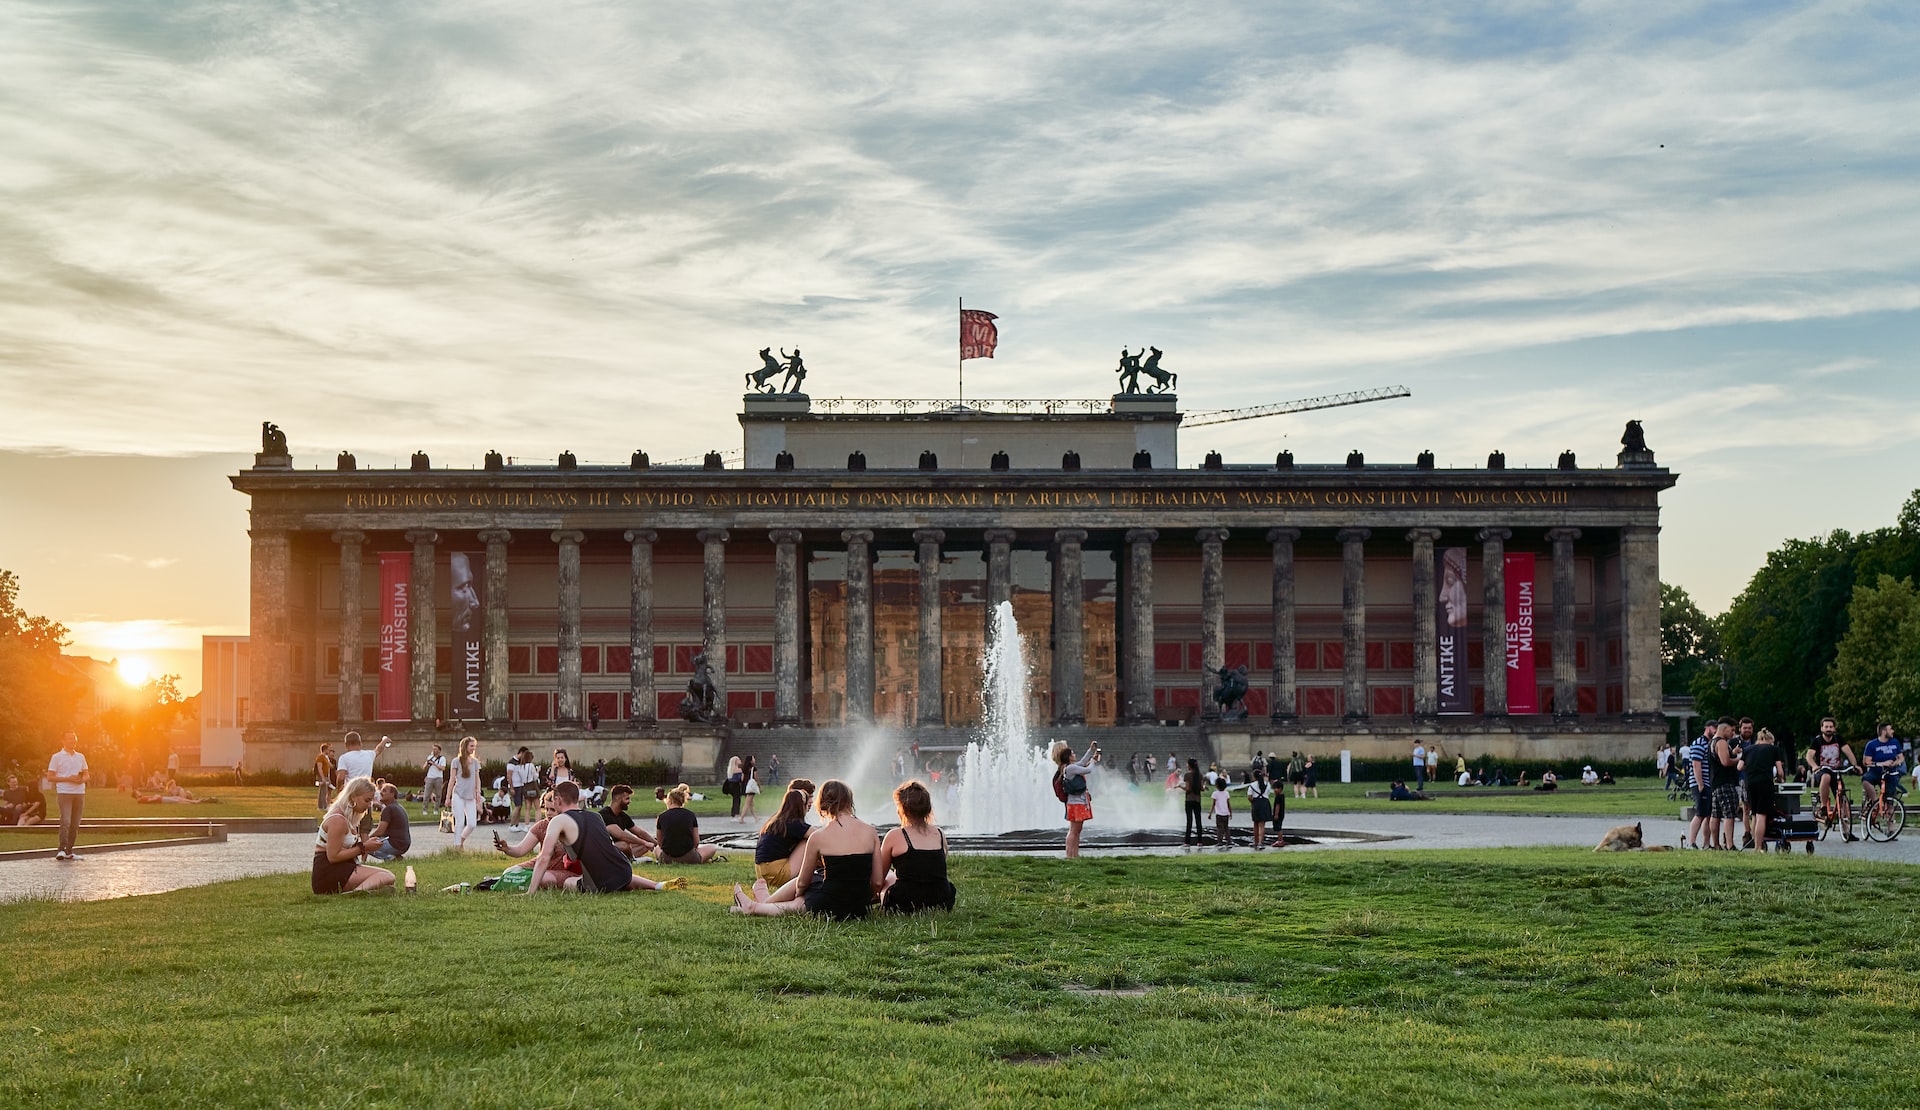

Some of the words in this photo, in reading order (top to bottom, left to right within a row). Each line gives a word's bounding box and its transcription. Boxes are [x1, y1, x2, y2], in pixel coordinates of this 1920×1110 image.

[346, 492, 457, 506] FRIDERICVS
[589, 492, 609, 506] III
[621, 492, 694, 506] STVDIO
[705, 492, 850, 506] ANTIQVITATIS
[859, 492, 983, 506] OMNIGENAE
[993, 492, 1018, 506] ET
[1025, 491, 1100, 505] ARTIVM
[1111, 491, 1227, 505] LIBERALIVM
[1237, 491, 1316, 505] MVSEVM
[1325, 490, 1442, 505] CONSTITVIT
[1452, 490, 1568, 505] MDCCCXXVIII
[394, 583, 407, 654] MUSEUM
[1506, 622, 1519, 670] ALTES
[1519, 582, 1533, 651] MUSEUM
[381, 624, 393, 673] ALTES
[466, 641, 480, 703] ANTIKE
[1440, 635, 1454, 697] ANTIKE
